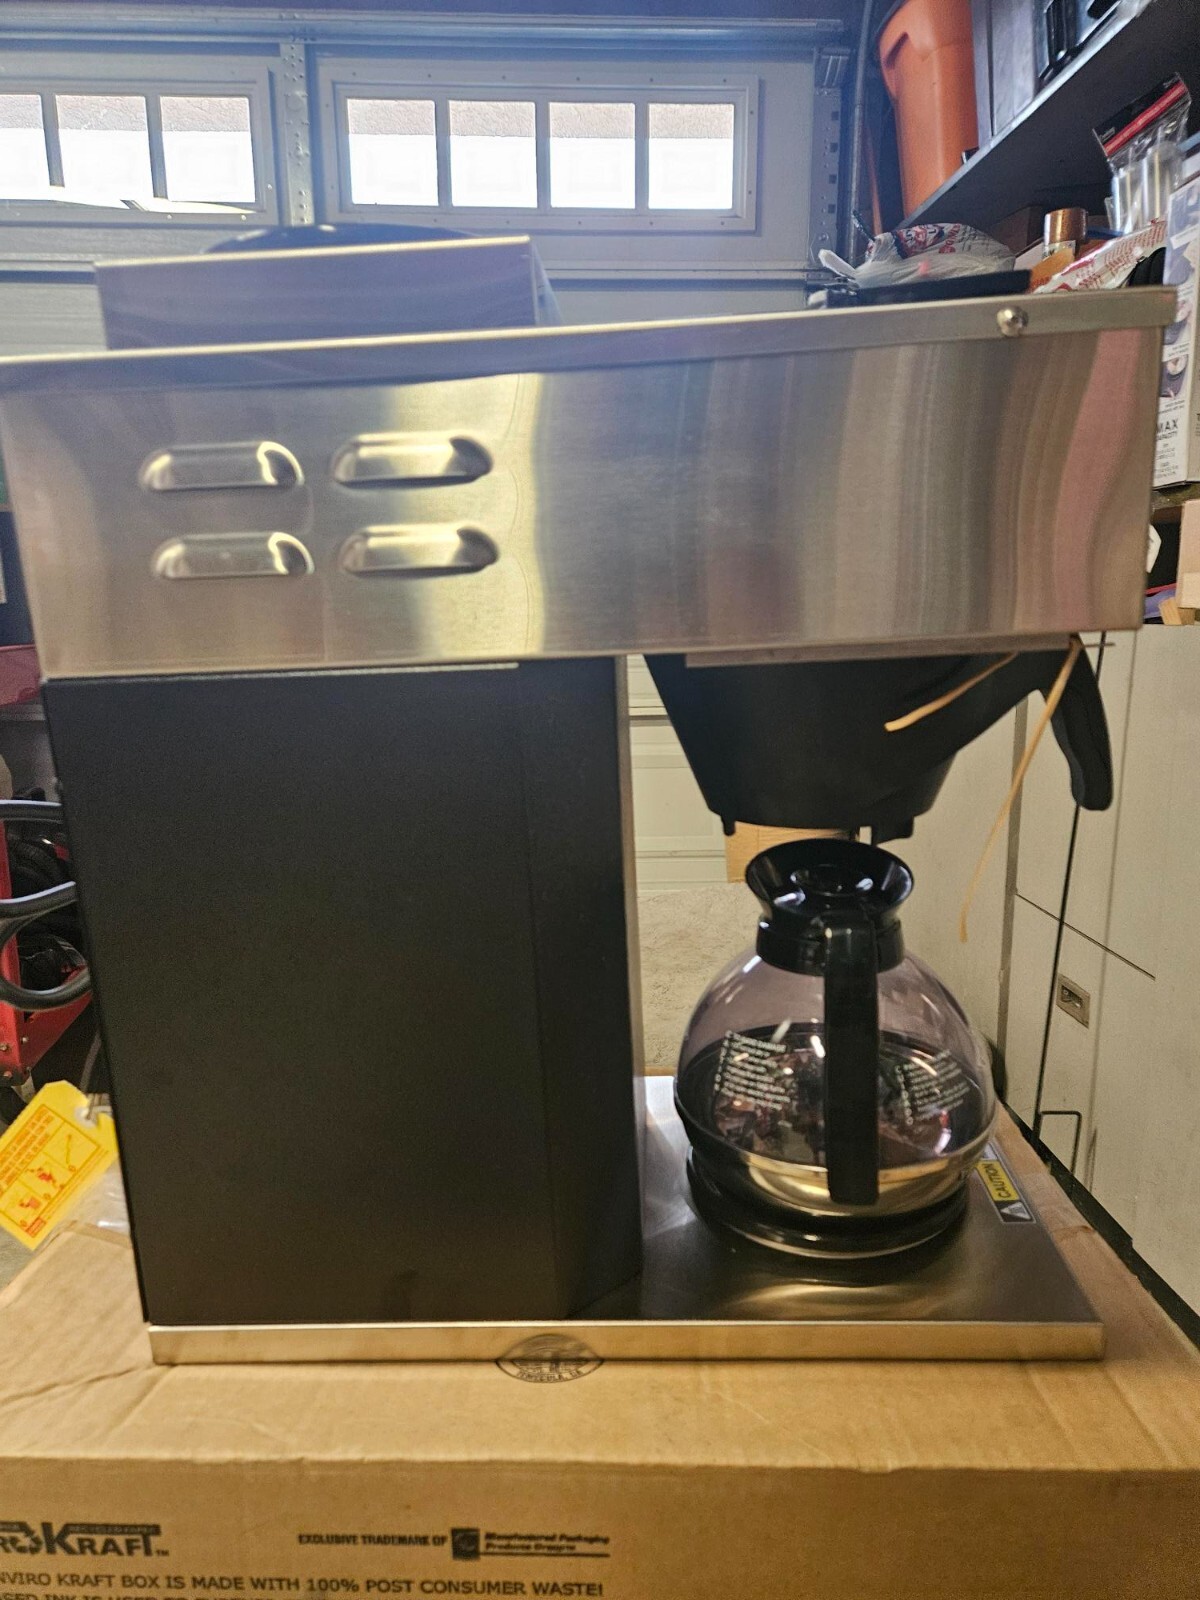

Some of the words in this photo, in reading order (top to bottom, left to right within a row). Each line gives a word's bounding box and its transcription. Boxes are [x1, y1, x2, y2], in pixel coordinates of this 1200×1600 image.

[982, 1163, 1011, 1198] CAUTION
[298, 1533, 358, 1545] EXCLUSIVE
[361, 1534, 430, 1546] TRADEMARK
[432, 1535, 448, 1546] OF
[57, 1573, 116, 1589] KRAFT
[121, 1574, 161, 1589] BOX
[165, 1575, 186, 1590] IS
[191, 1576, 245, 1590] MADE
[249, 1577, 300, 1591] WITH
[307, 1578, 360, 1593] 100%
[365, 1579, 415, 1593] POST
[420, 1579, 526, 1595] CONSUMER
